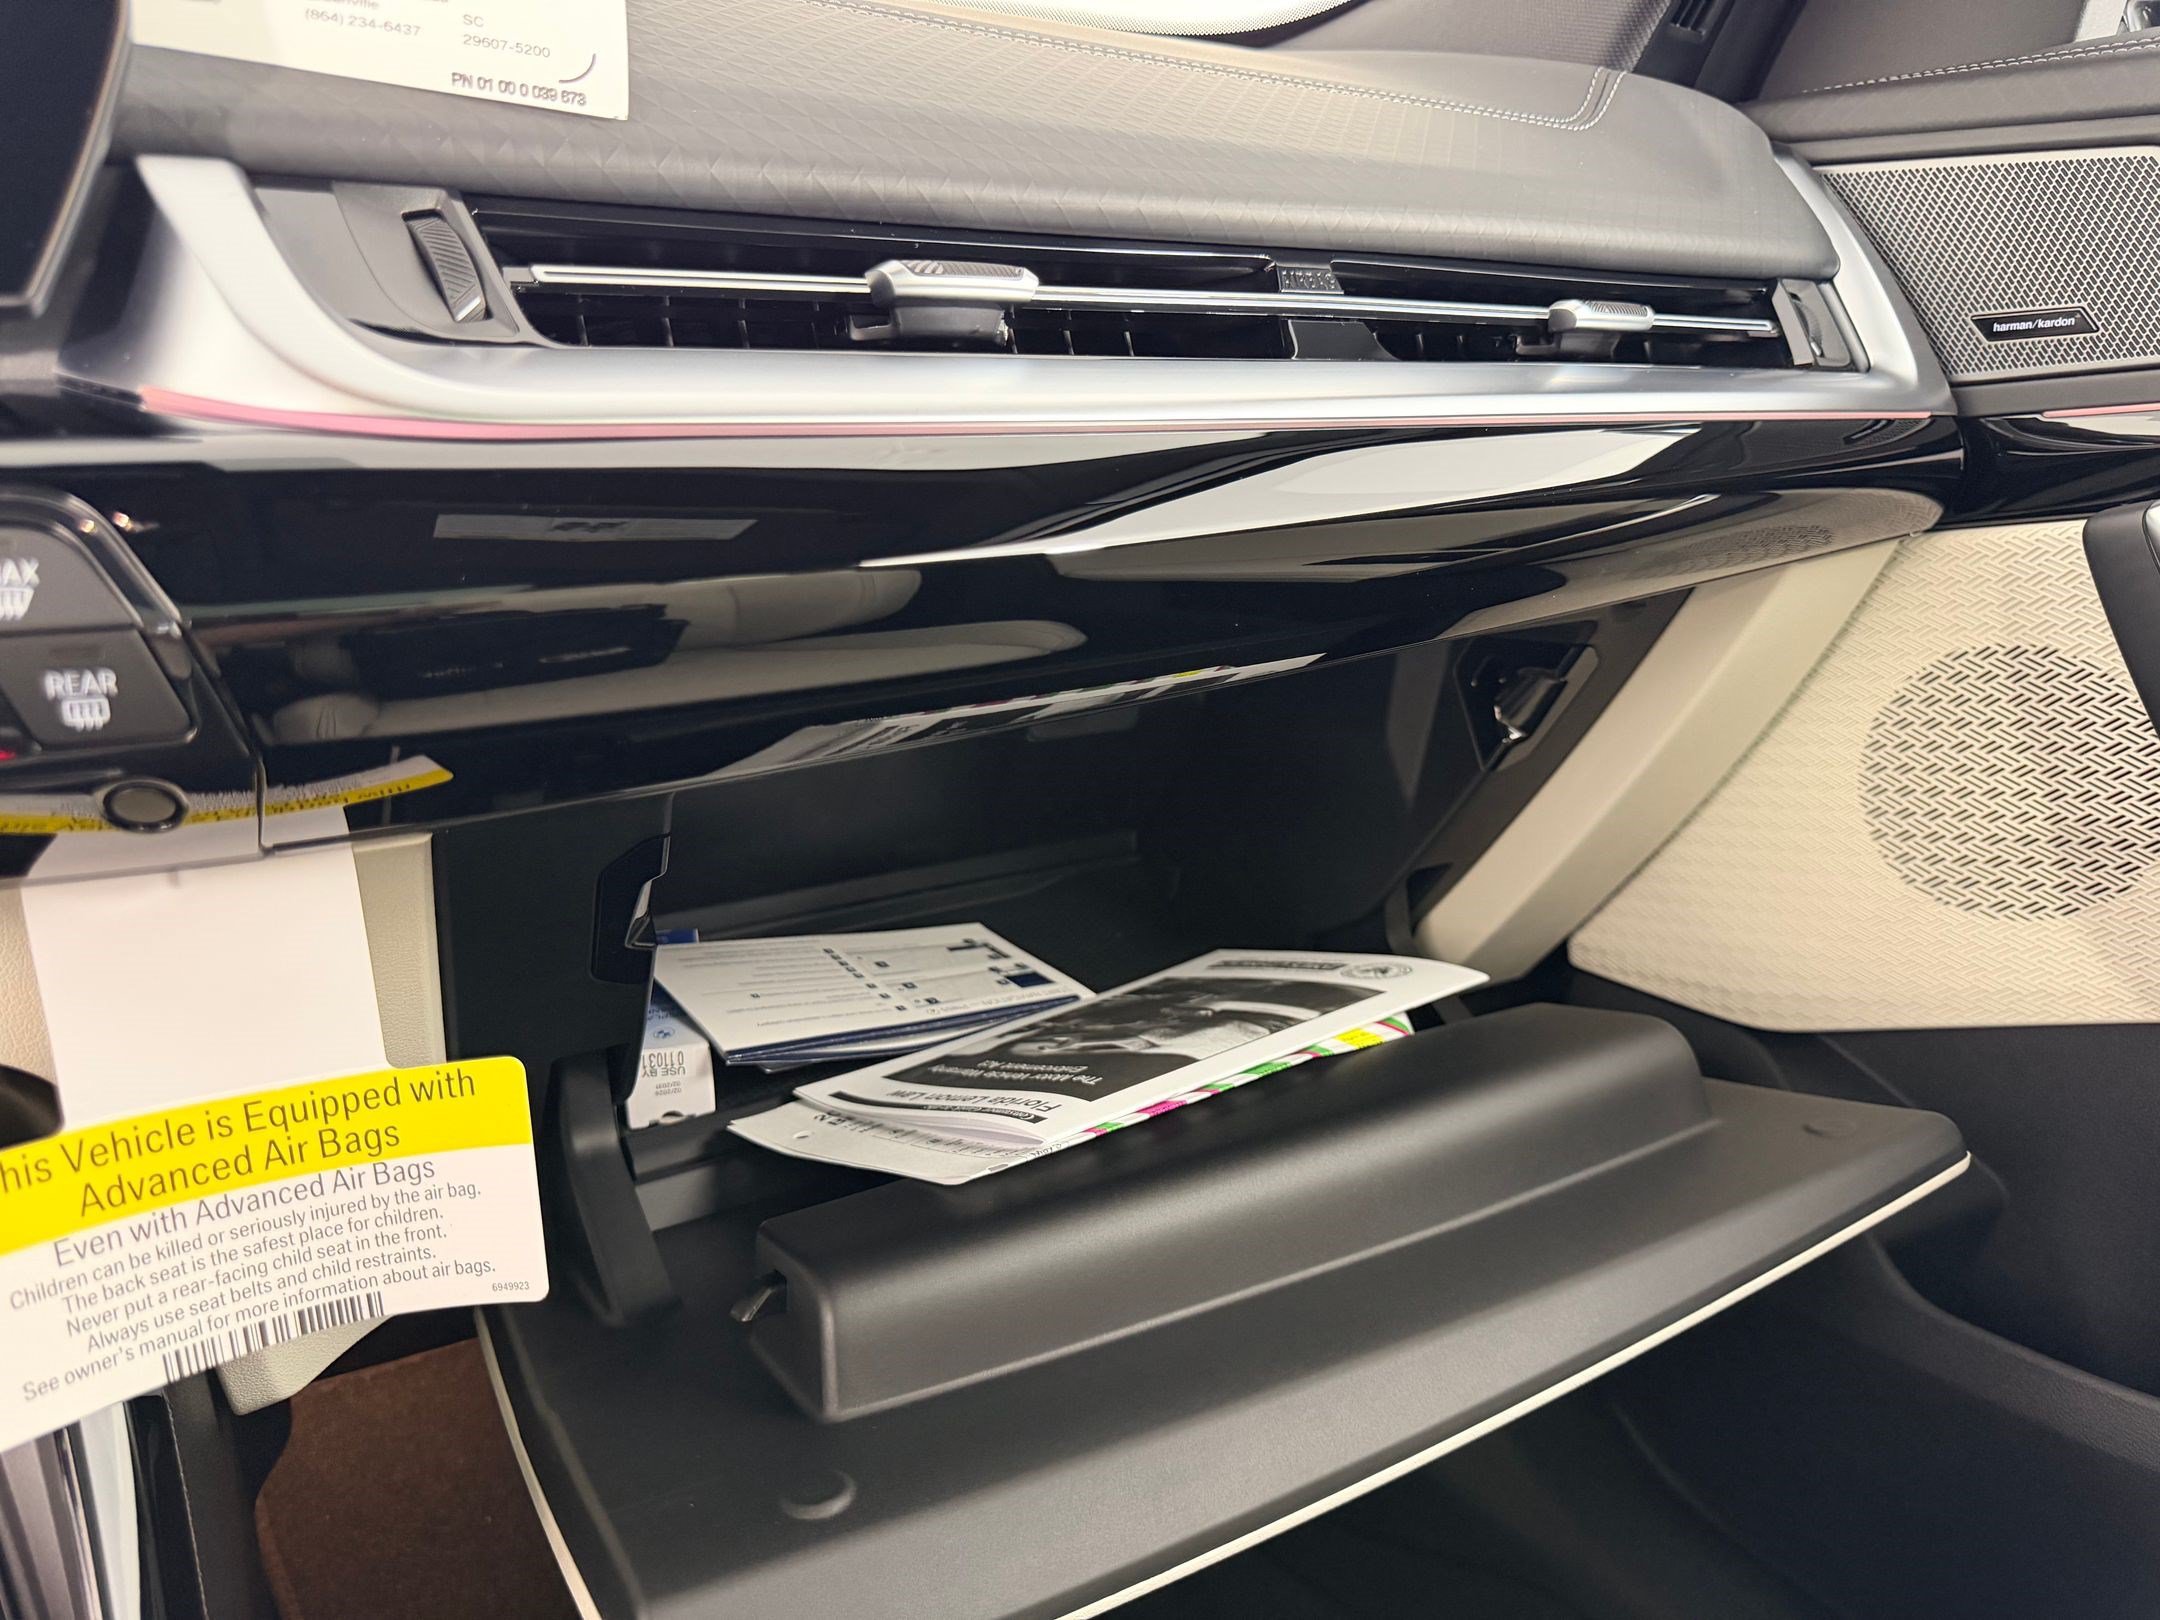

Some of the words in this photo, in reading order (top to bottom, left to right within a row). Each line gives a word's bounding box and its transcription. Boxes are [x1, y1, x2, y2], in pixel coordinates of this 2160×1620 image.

[304, 8, 344, 26] (864)
[347, 15, 422, 37] 234-6437
[462, 14, 484, 28] SC
[462, 33, 551, 58] 29607-5200
[451, 72, 473, 88] PN
[476, 76, 494, 92] 01
[497, 79, 516, 95] 00
[519, 83, 529, 97] 0
[1992, 316, 2076, 333] harman/kardon
[0, 557, 40, 588] AX
[44, 667, 119, 699] REAR
[642, 1067, 658, 1078] BY
[661, 1066, 686, 1077] USE
[1072, 1074, 1104, 1086] The
[987, 1096, 1063, 1113] Florida
[0, 1153, 53, 1194] his
[60, 1118, 196, 1174] Vehicle
[204, 1109, 234, 1141] is
[243, 1076, 402, 1133] Equipped
[409, 1068, 476, 1102] with
[80, 1144, 253, 1218] Advanced
[264, 1136, 309, 1170] Air
[318, 1124, 401, 1158] Bags
[53, 1229, 124, 1268] Even
[129, 1206, 188, 1243] with
[195, 1173, 325, 1226] Advanced
[332, 1167, 366, 1194] Air
[372, 1160, 436, 1186] Bags
[9, 1271, 88, 1311] Children
[92, 1258, 125, 1282] can
[129, 1252, 152, 1270] be
[155, 1234, 204, 1256] killed
[207, 1230, 226, 1246] or
[230, 1209, 306, 1241] seriously
[309, 1196, 368, 1223] injured
[371, 1192, 390, 1211] by
[394, 1188, 421, 1206] the
[424, 1184, 444, 1200] air
[447, 1182, 481, 1199] bag.
[63, 1290, 99, 1315] The
[102, 1277, 147, 1301] back
[149, 1263, 189, 1286] seat
[191, 1256, 207, 1272] is
[210, 1249, 239, 1267] the
[242, 1235, 297, 1258] safest
[299, 1223, 344, 1248] place
[347, 1217, 370, 1234] for
[374, 1206, 444, 1228] children.
[65, 1308, 120, 1338] Never
[124, 1294, 154, 1320] put
[157, 1291, 168, 1305] a
[171, 1261, 269, 1301] rear-facing
[272, 1246, 313, 1270] child
[316, 1239, 352, 1259] seat
[355, 1235, 371, 1251] in
[374, 1229, 401, 1248] the
[404, 1224, 448, 1243] front.
[491, 1281, 530, 1293] 6949923
[87, 1317, 150, 1353] Always
[153, 1306, 185, 1329] use
[189, 1293, 227, 1316] seat
[229, 1279, 273, 1304] belts
[276, 1267, 309, 1290] and
[312, 1258, 352, 1282] child
[355, 1247, 437, 1271] restraints.
[22, 1375, 60, 1402] See
[64, 1346, 136, 1384] owner's
[138, 1322, 204, 1358] manual
[207, 1313, 231, 1332] for
[234, 1299, 280, 1325] more
[282, 1275, 380, 1309] information
[382, 1264, 429, 1286] about
[432, 1261, 451, 1278] air
[454, 1259, 496, 1277] bags.
